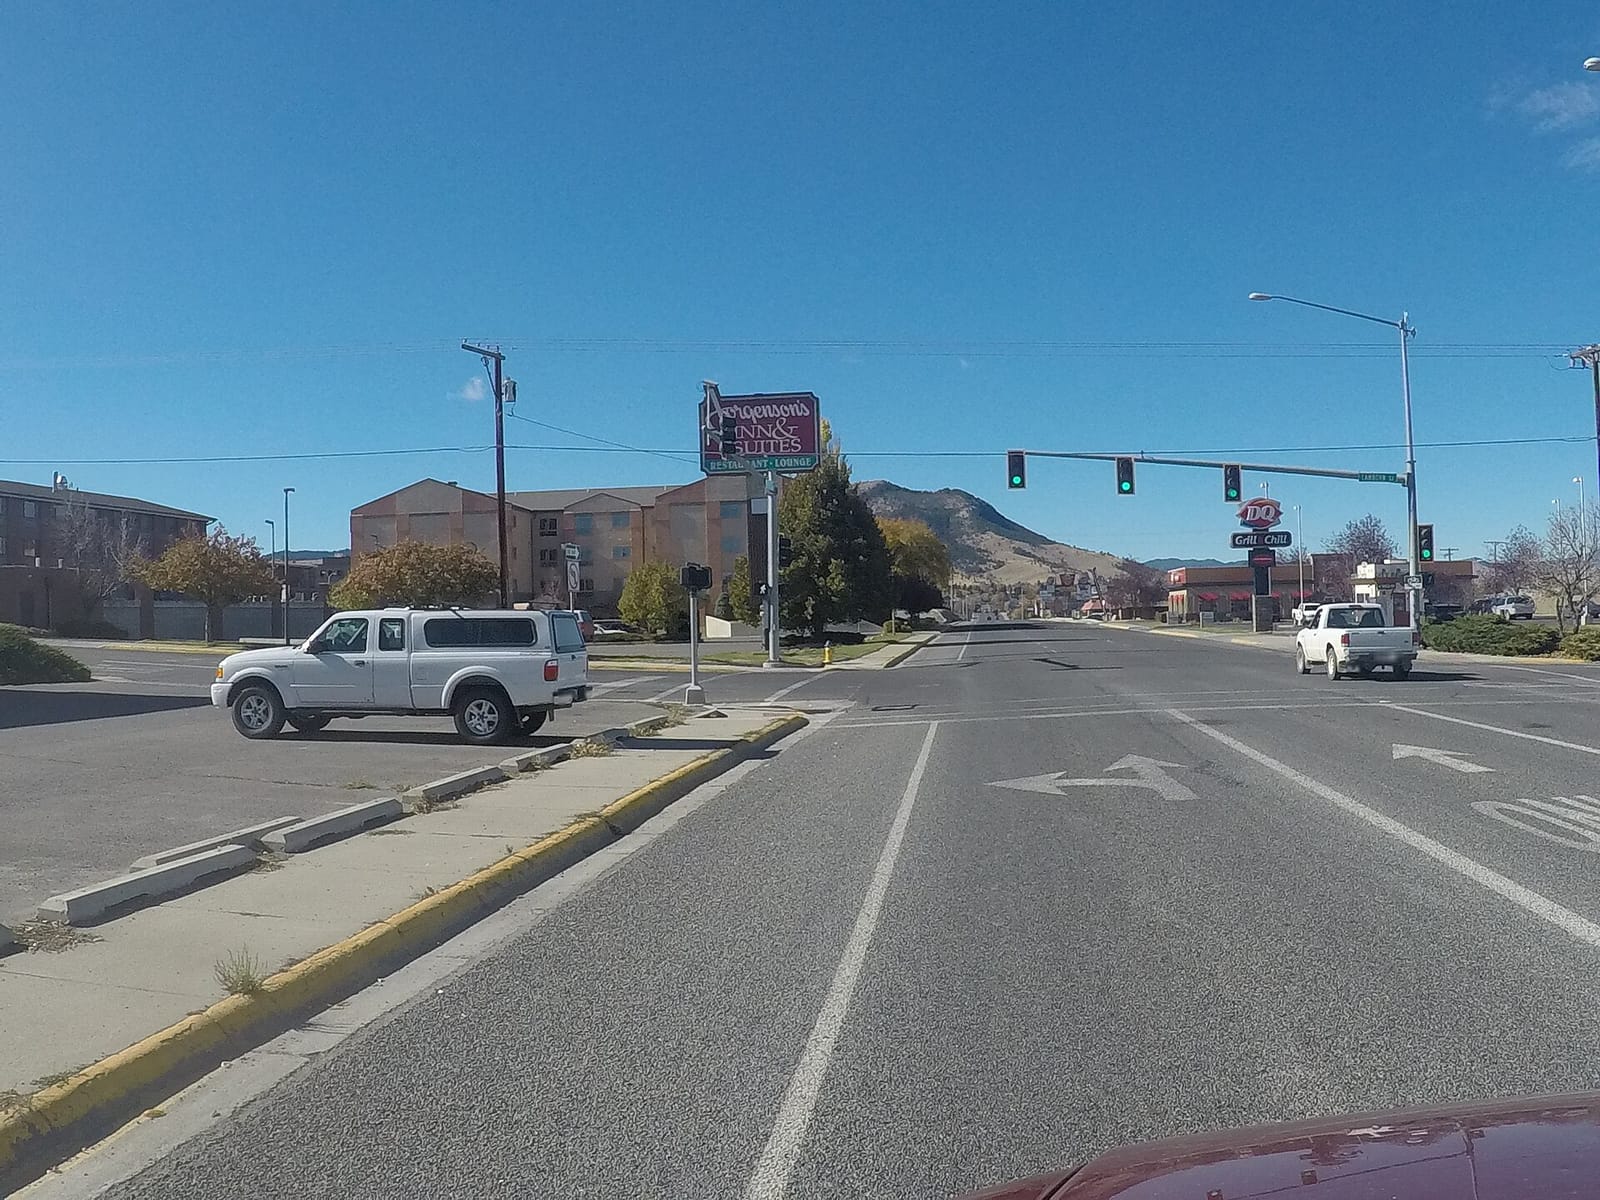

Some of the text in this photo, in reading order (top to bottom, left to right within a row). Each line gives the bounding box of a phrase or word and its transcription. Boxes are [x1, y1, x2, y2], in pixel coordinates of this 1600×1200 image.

[735, 417, 799, 440] INN &
[735, 439, 802, 455] SUITES
[775, 457, 812, 468] LOUNGE
[1246, 505, 1276, 521] DQ
[1235, 534, 1288, 545] Grill Chill
